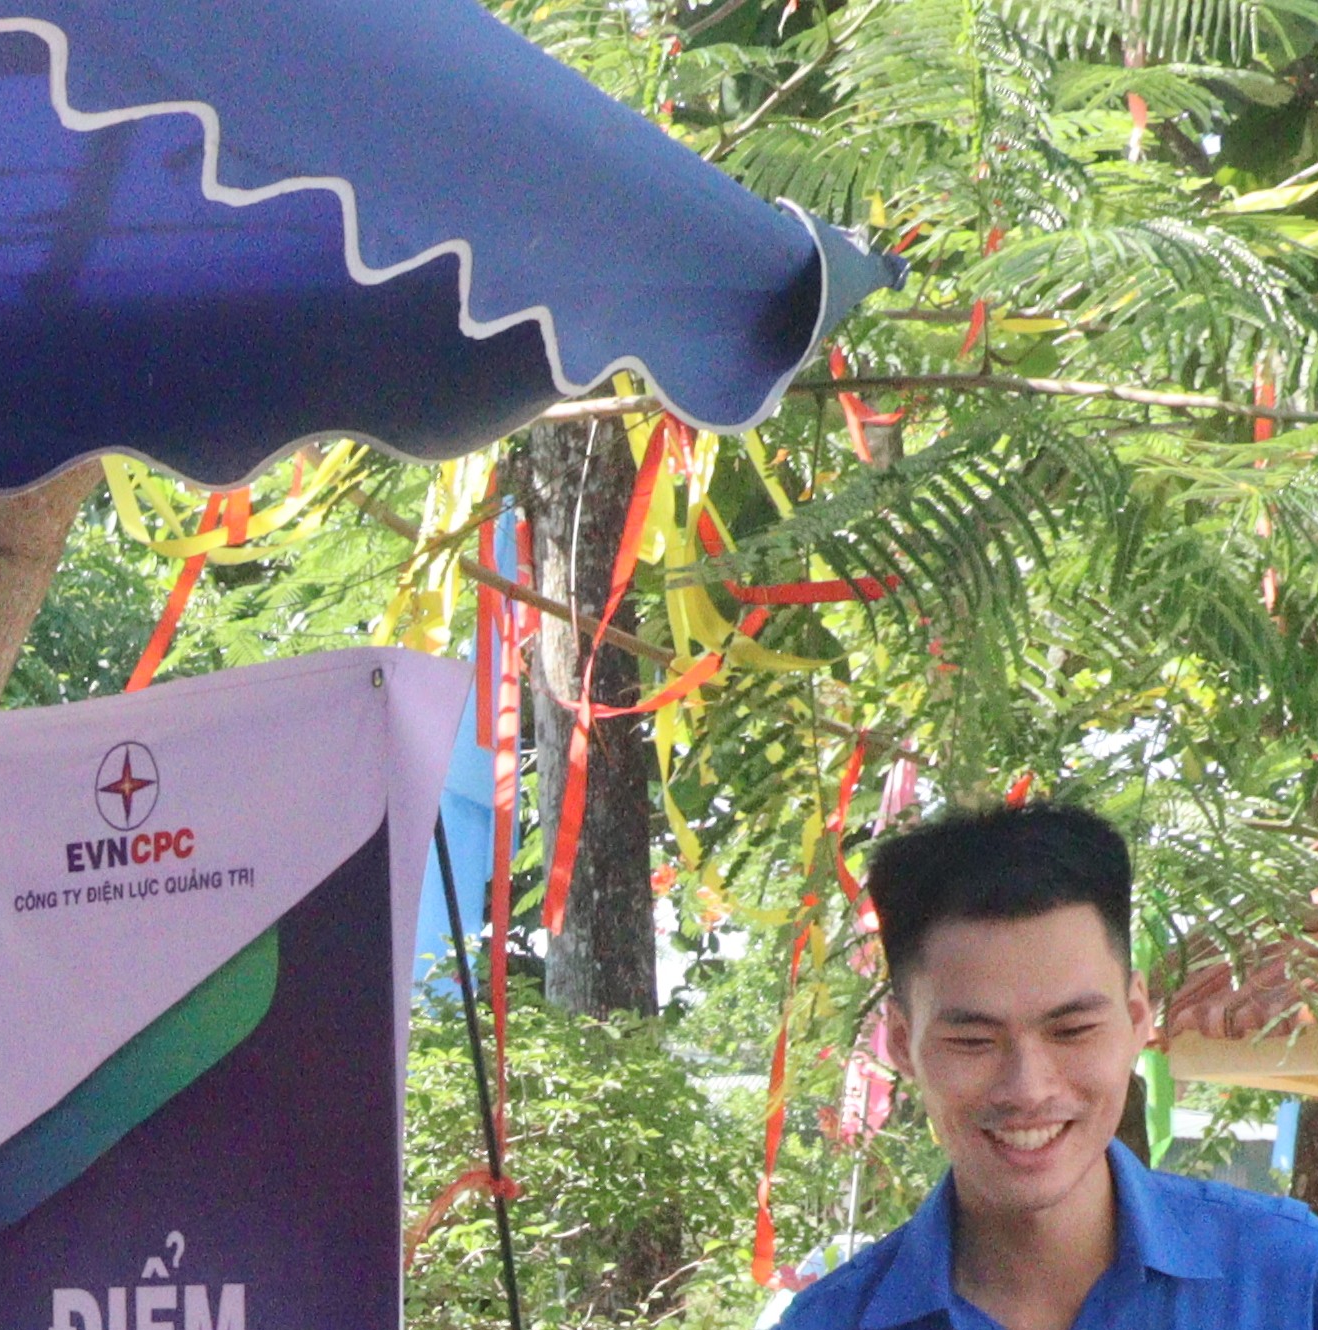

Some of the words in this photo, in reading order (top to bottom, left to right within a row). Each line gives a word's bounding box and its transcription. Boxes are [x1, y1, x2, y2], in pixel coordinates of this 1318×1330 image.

[67, 828, 195, 873] EVNCPC
[14, 890, 57, 912] CÔNG
[63, 889, 82, 906] TY
[86, 881, 124, 904] ĐIỆN
[129, 879, 159, 901] LỰC
[165, 868, 222, 894] QUẢNG
[228, 867, 255, 888] TRỊ
